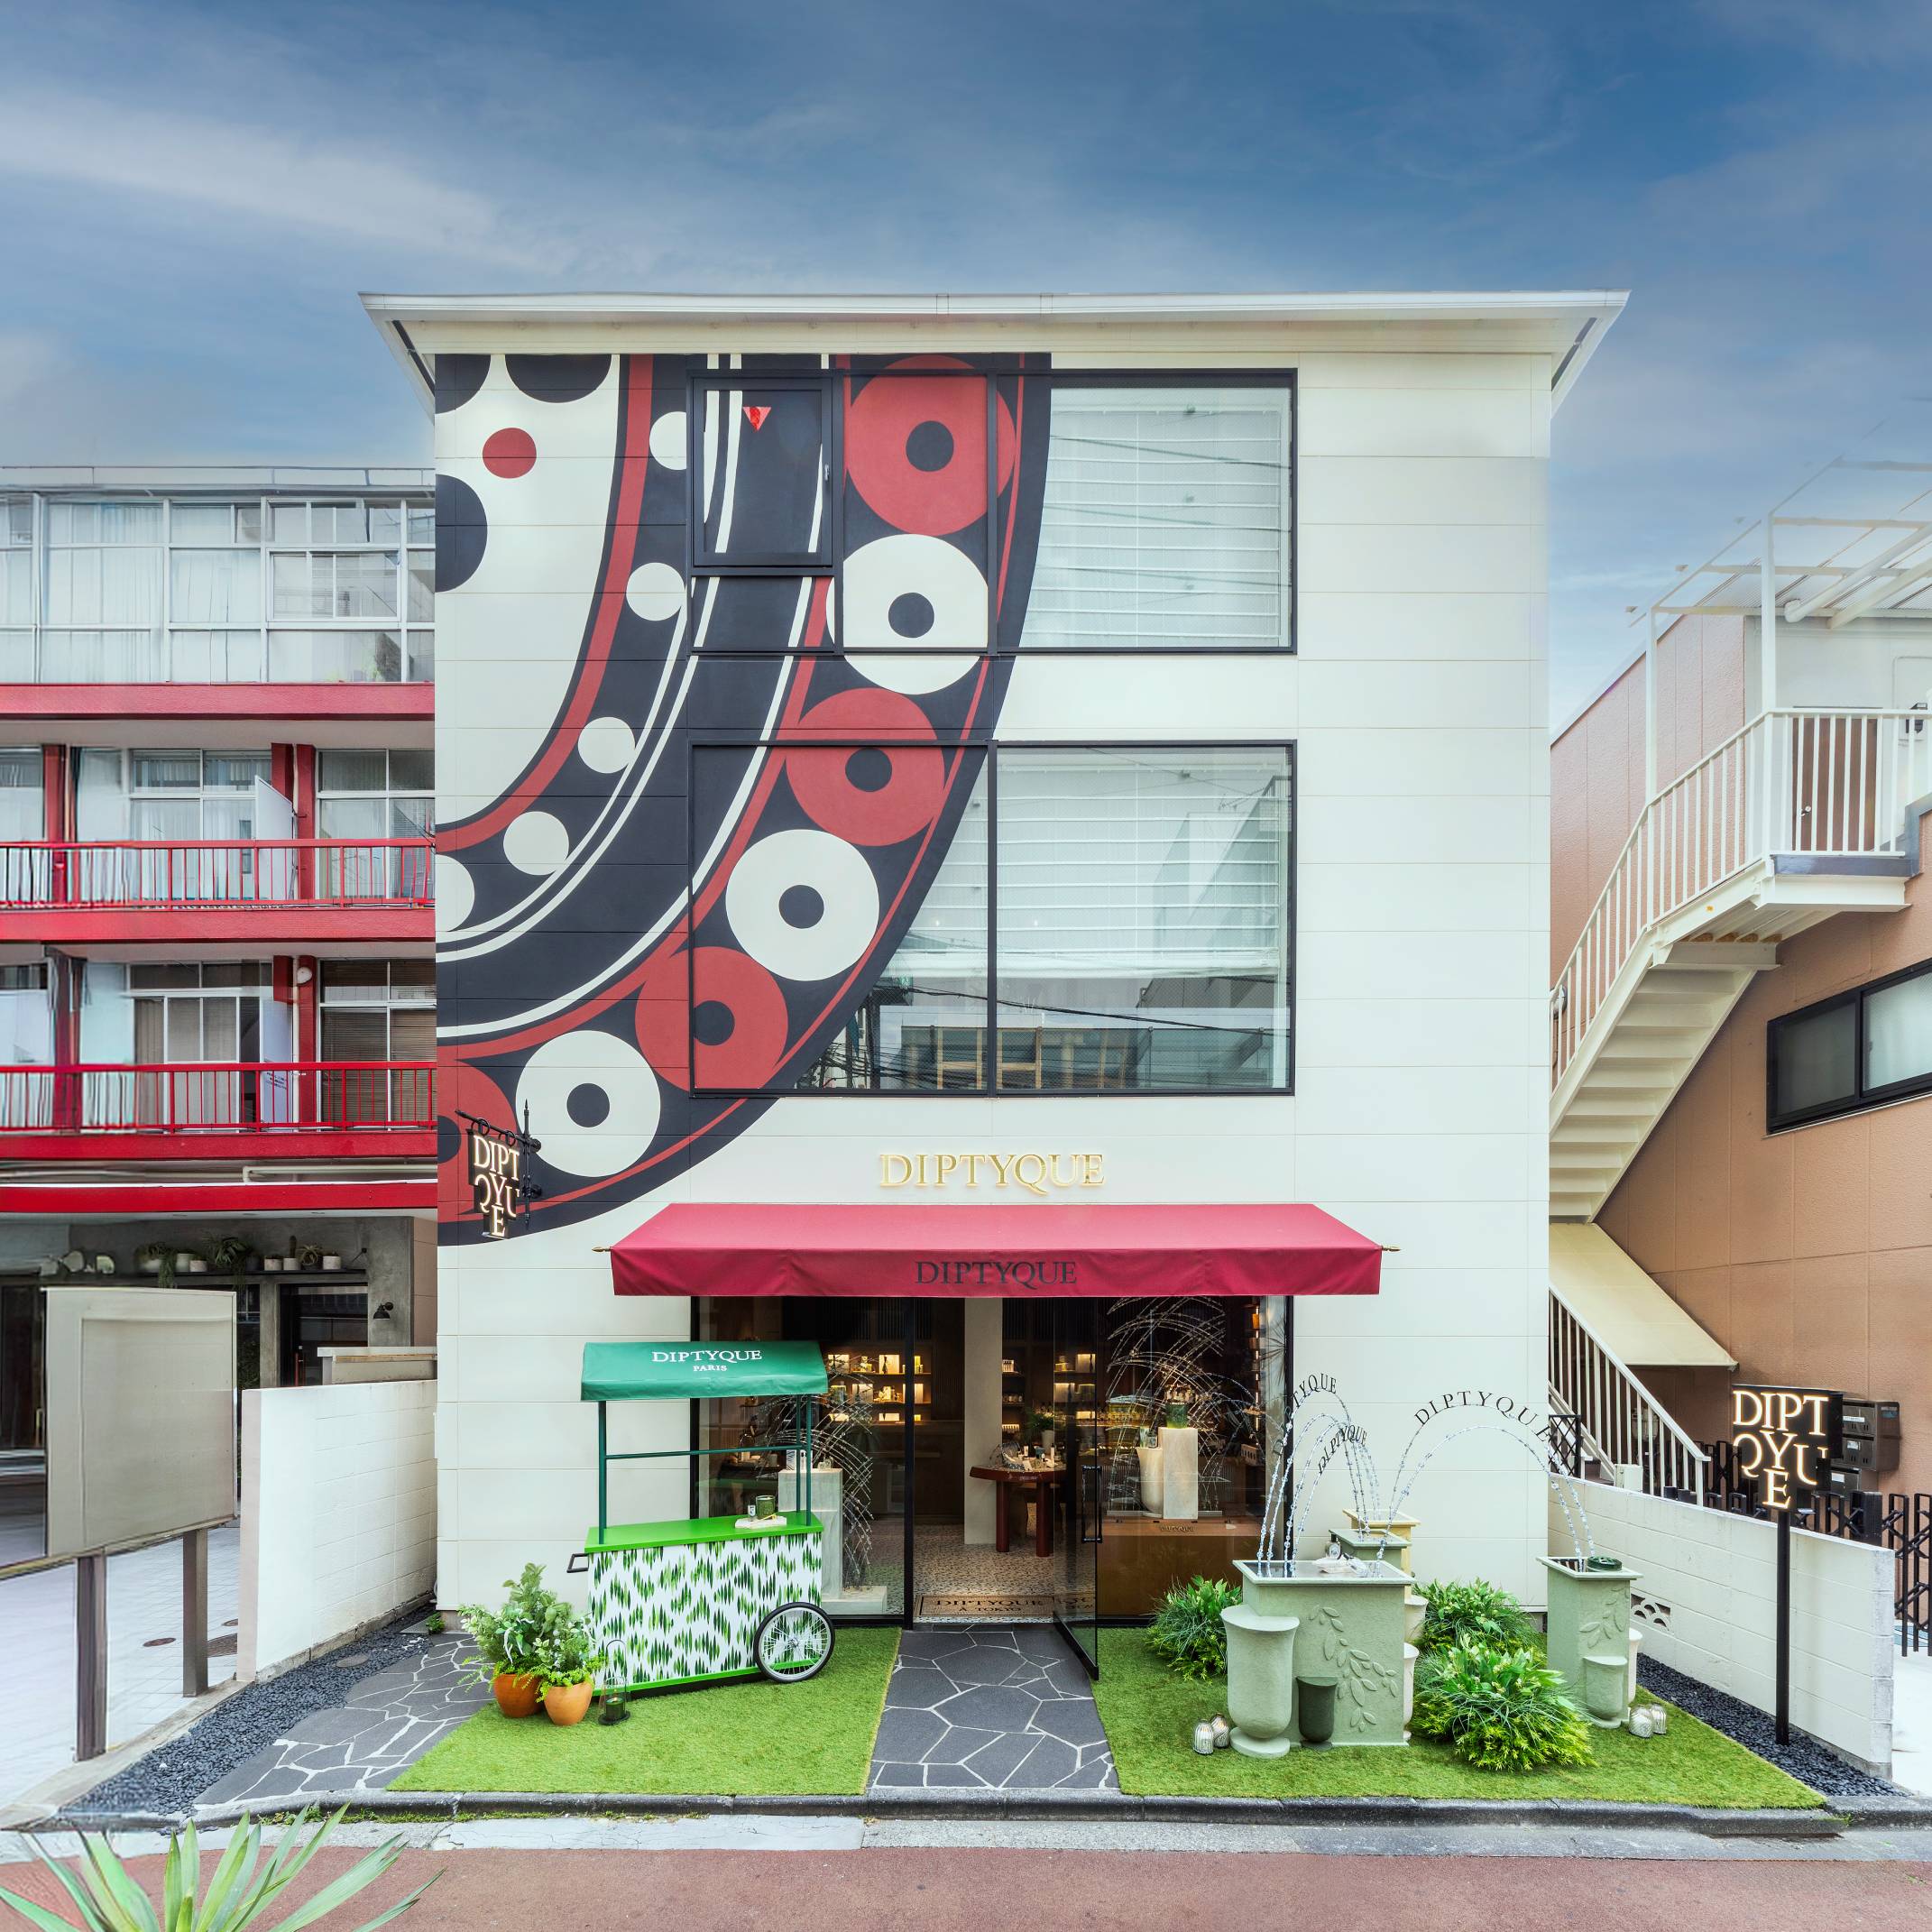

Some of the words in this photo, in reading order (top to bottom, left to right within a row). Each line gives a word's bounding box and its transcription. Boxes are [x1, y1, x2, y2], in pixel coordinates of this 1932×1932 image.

[474, 1135, 520, 1182] DIPT
[879, 1154, 1105, 1195] DIPTYQUE
[490, 1205, 506, 1237] E
[915, 1261, 1077, 1290] DIPTYQUE
[652, 1350, 762, 1363] DIPTYQUE
[1414, 1390, 1551, 1443] DIPTYQUE
[1732, 1390, 1829, 1436] DIPT
[1318, 1424, 1367, 1476] DIPTYQUE
[1762, 1468, 1791, 1509] E
